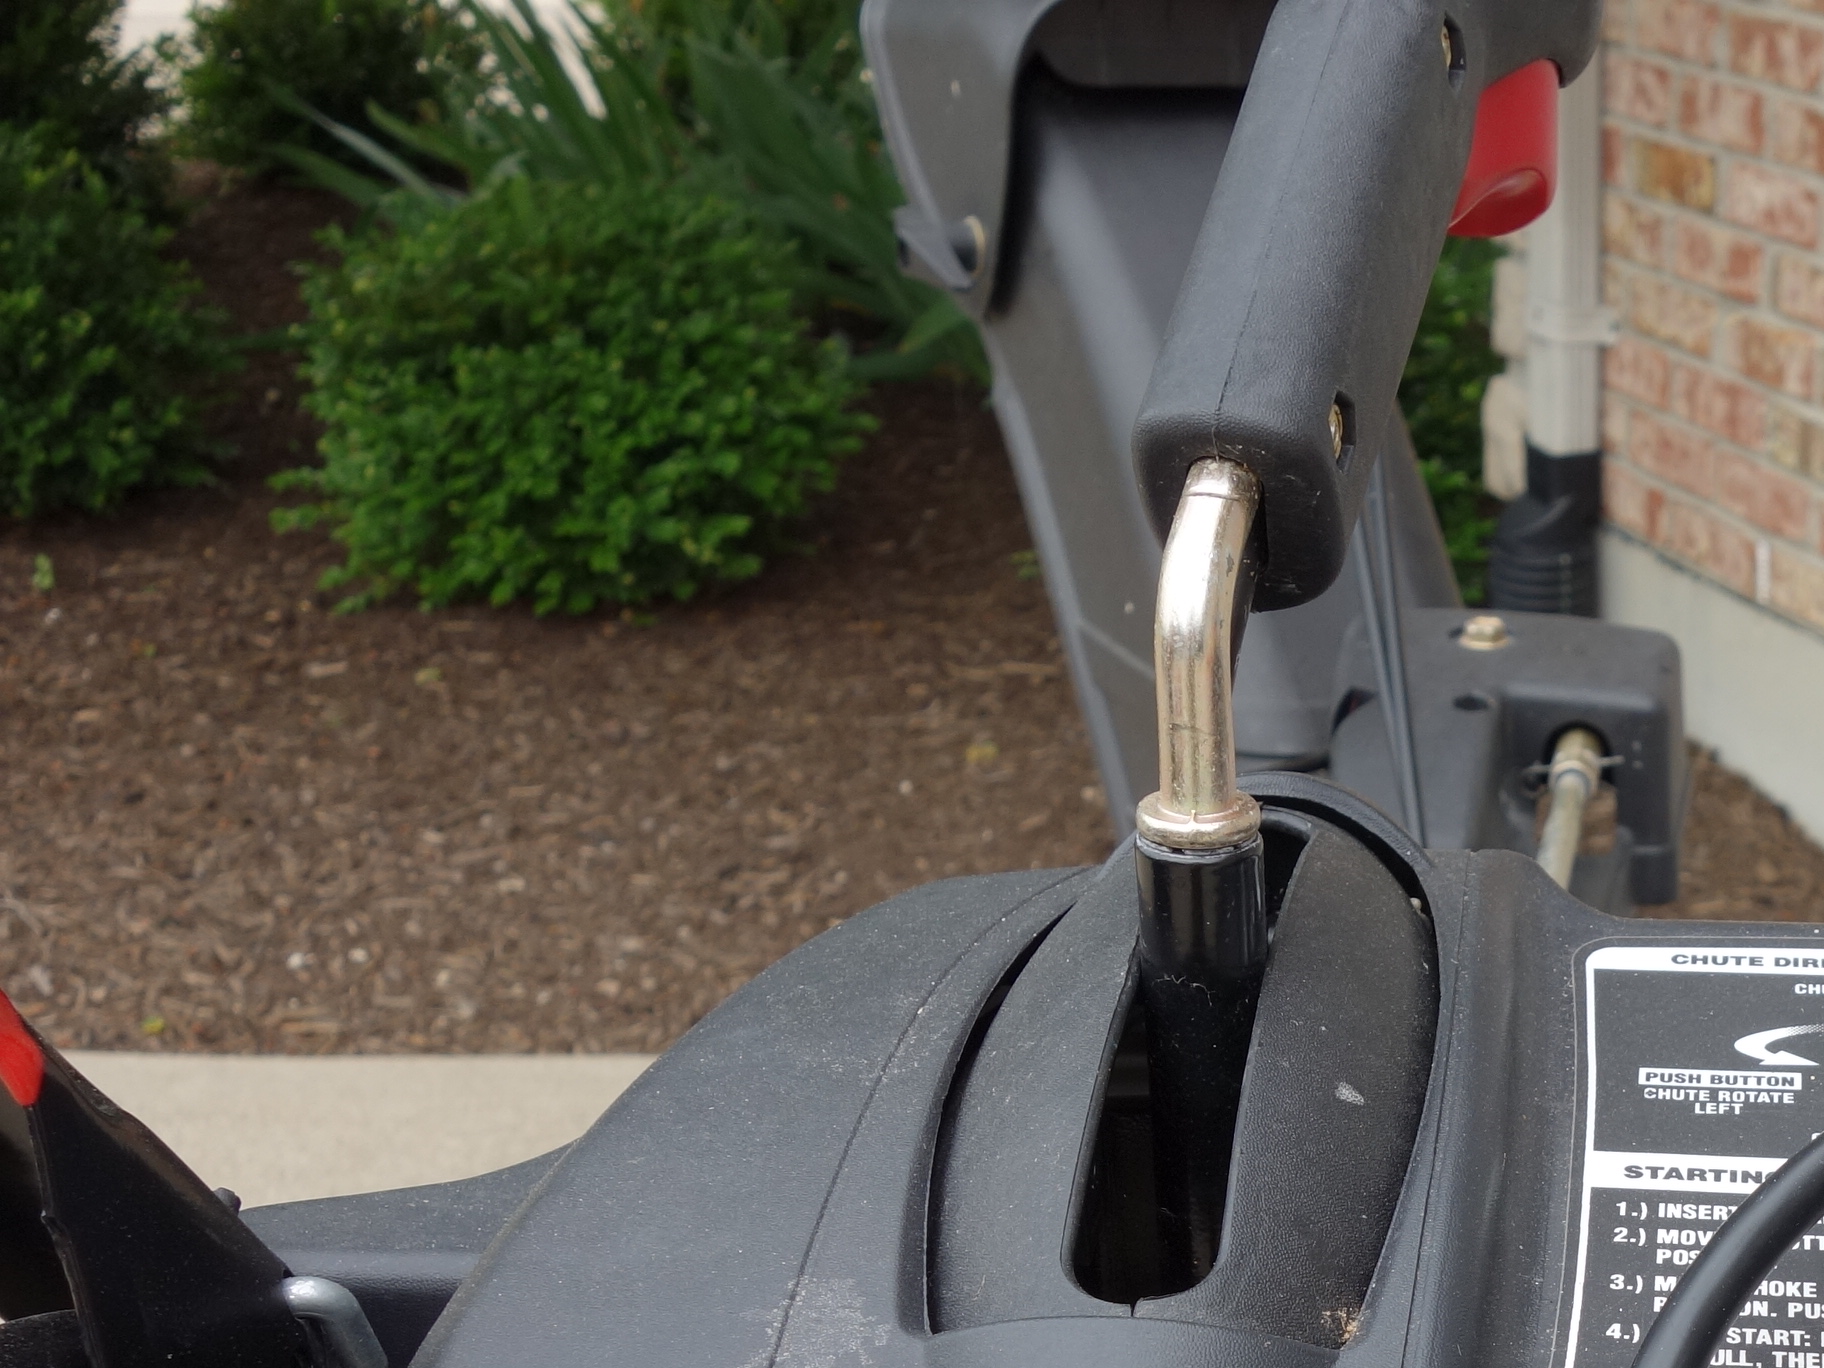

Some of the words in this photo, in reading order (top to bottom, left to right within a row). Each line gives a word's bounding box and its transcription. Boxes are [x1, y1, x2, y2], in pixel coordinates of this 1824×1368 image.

[1671, 953, 1763, 969] CHUTE
[1645, 1071, 1706, 1087] PUSH
[1710, 1072, 1796, 1088] BUTTON
[1643, 1086, 1713, 1103] CHUTE
[1716, 1089, 1795, 1104] ROTATE
[1694, 1101, 1744, 1116] LEFT
[1615, 1201, 1649, 1221] 1.)
[1613, 1226, 1647, 1247] 2.)
[1656, 1228, 1713, 1247] MOV
[1609, 1273, 1643, 1294] 3.)
[1753, 1279, 1817, 1299] HOKE
[1605, 1322, 1641, 1343] 4.)
[1725, 1327, 1811, 1347] START:
